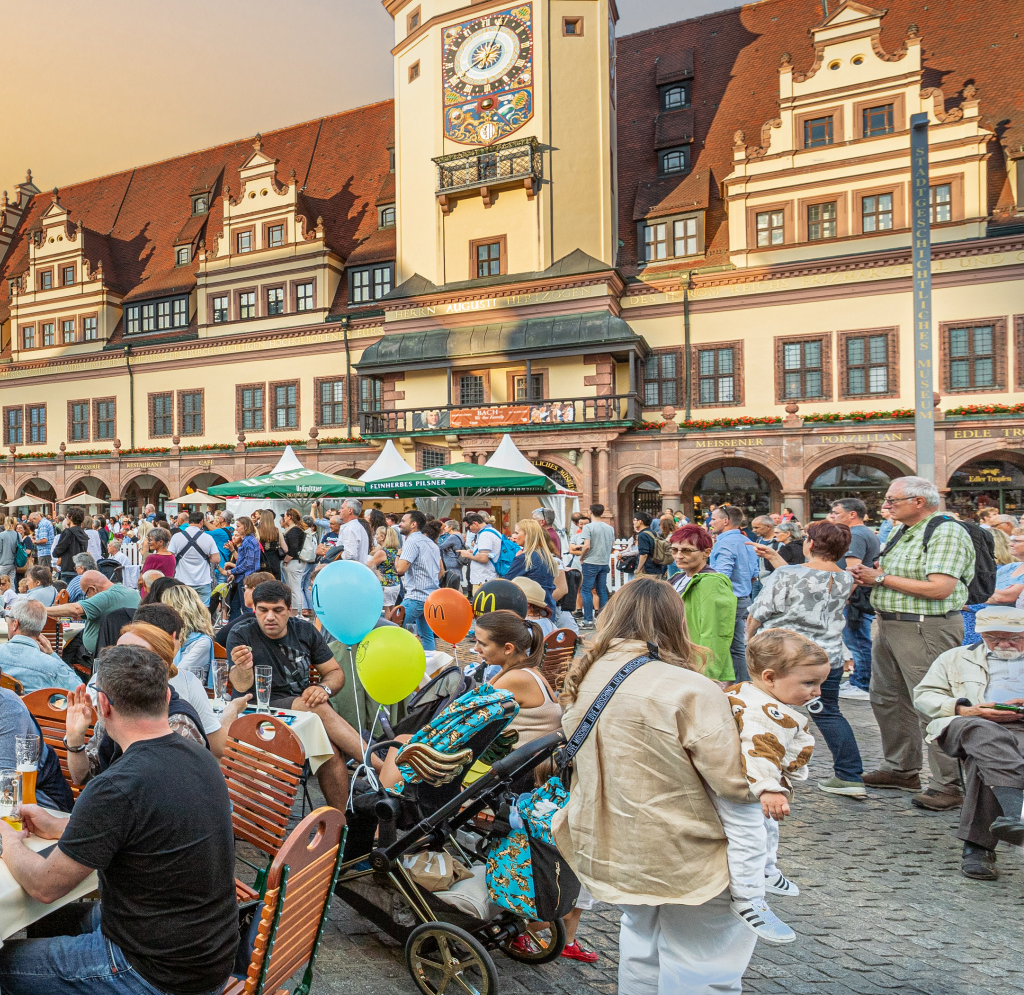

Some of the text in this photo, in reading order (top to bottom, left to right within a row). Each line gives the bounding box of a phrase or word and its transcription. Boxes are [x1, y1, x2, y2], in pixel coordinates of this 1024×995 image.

[629, 295, 656, 305] DES
[730, 280, 790, 294] REICHS
[959, 254, 1004, 268] UND
[916, 147, 932, 420] STADTGESCHICHTLICHES MUSEUM
[394, 287, 592, 319] HERRN AUGUSTI HERTZOGEN
[696, 433, 903, 448] MEISSENER PORZELLAN
[954, 430, 992, 438] EDLE
[370, 481, 412, 490] FEINHERBES
[416, 478, 446, 488] PILSNER
